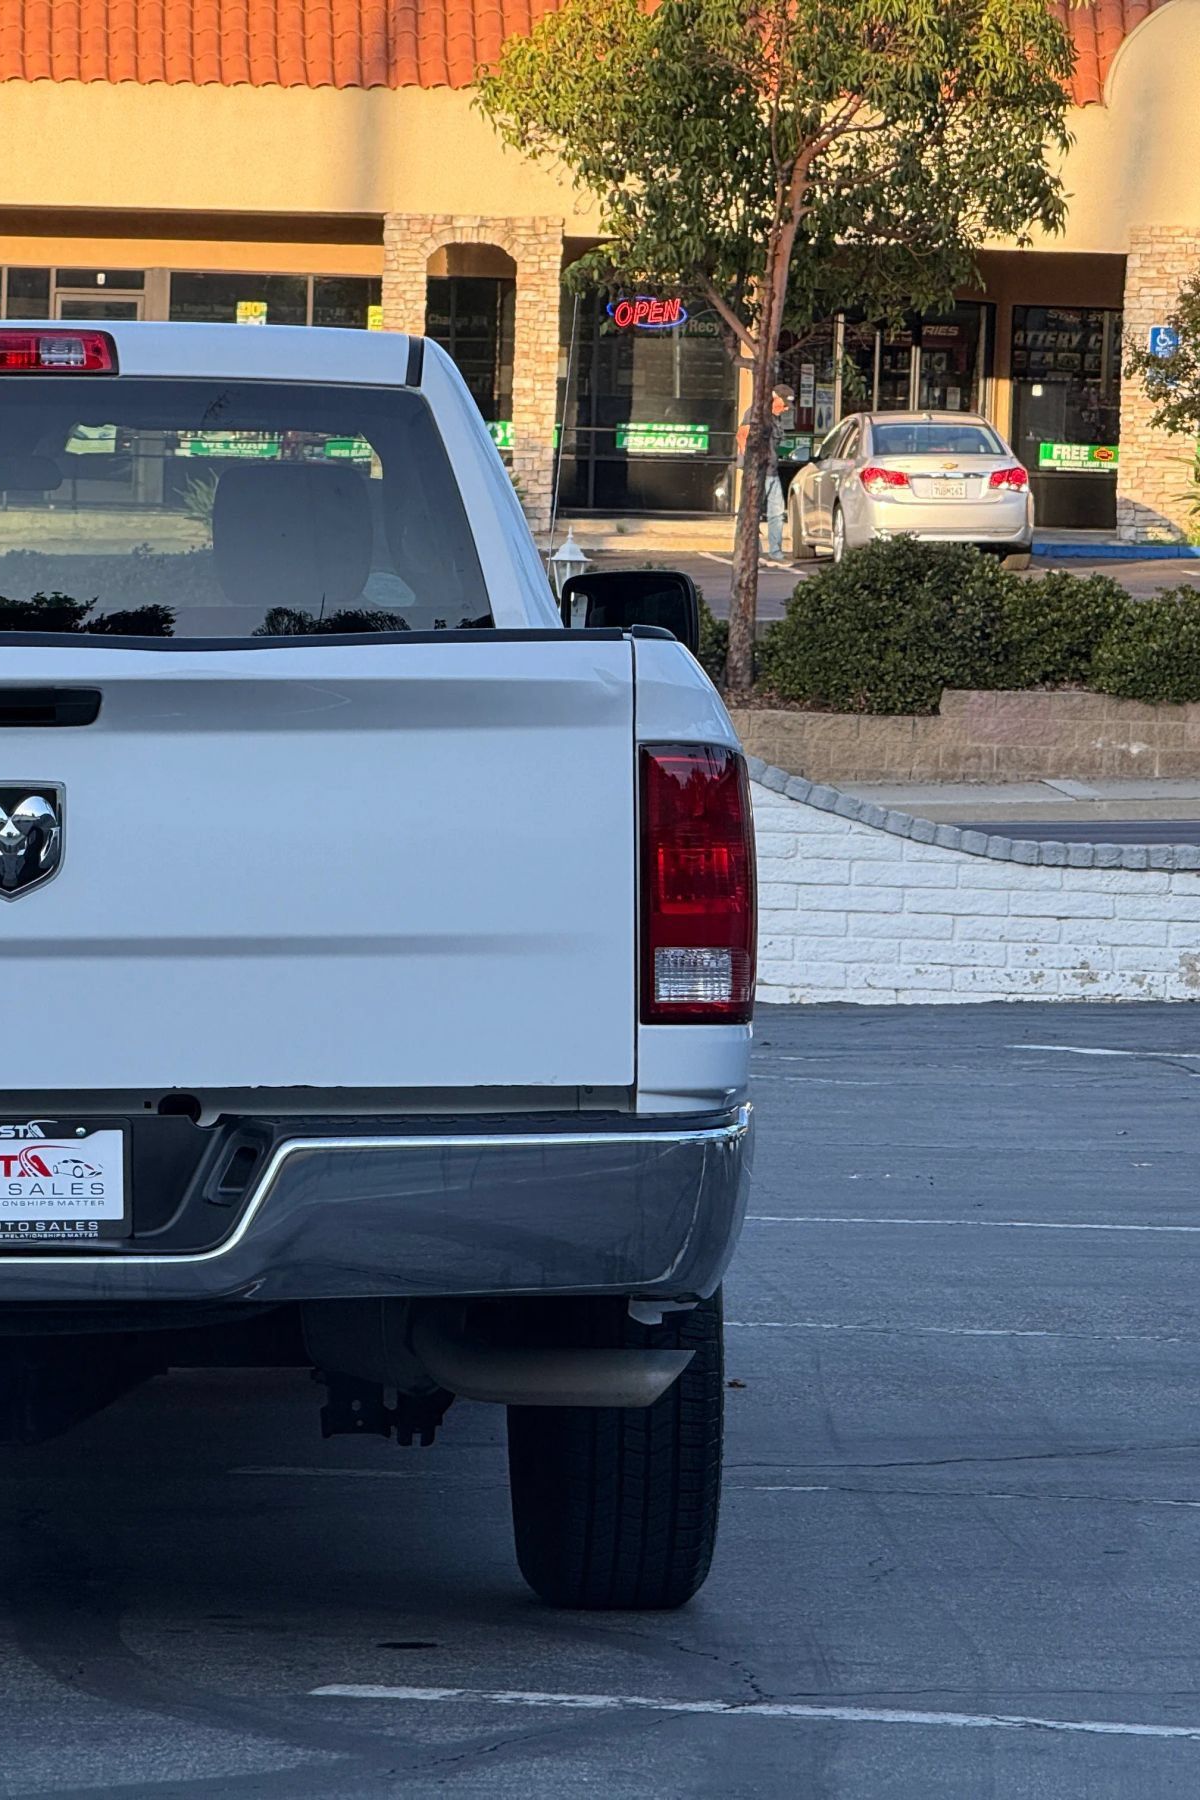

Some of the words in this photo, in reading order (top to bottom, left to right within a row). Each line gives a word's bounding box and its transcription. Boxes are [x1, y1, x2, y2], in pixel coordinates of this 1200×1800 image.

[615, 298, 681, 327] OPEN
[1013, 330, 1082, 349] ATTERY
[1052, 444, 1089, 460] FREE
[8, 1182, 104, 1196] SALES
[35, 1221, 99, 1231] SALES
